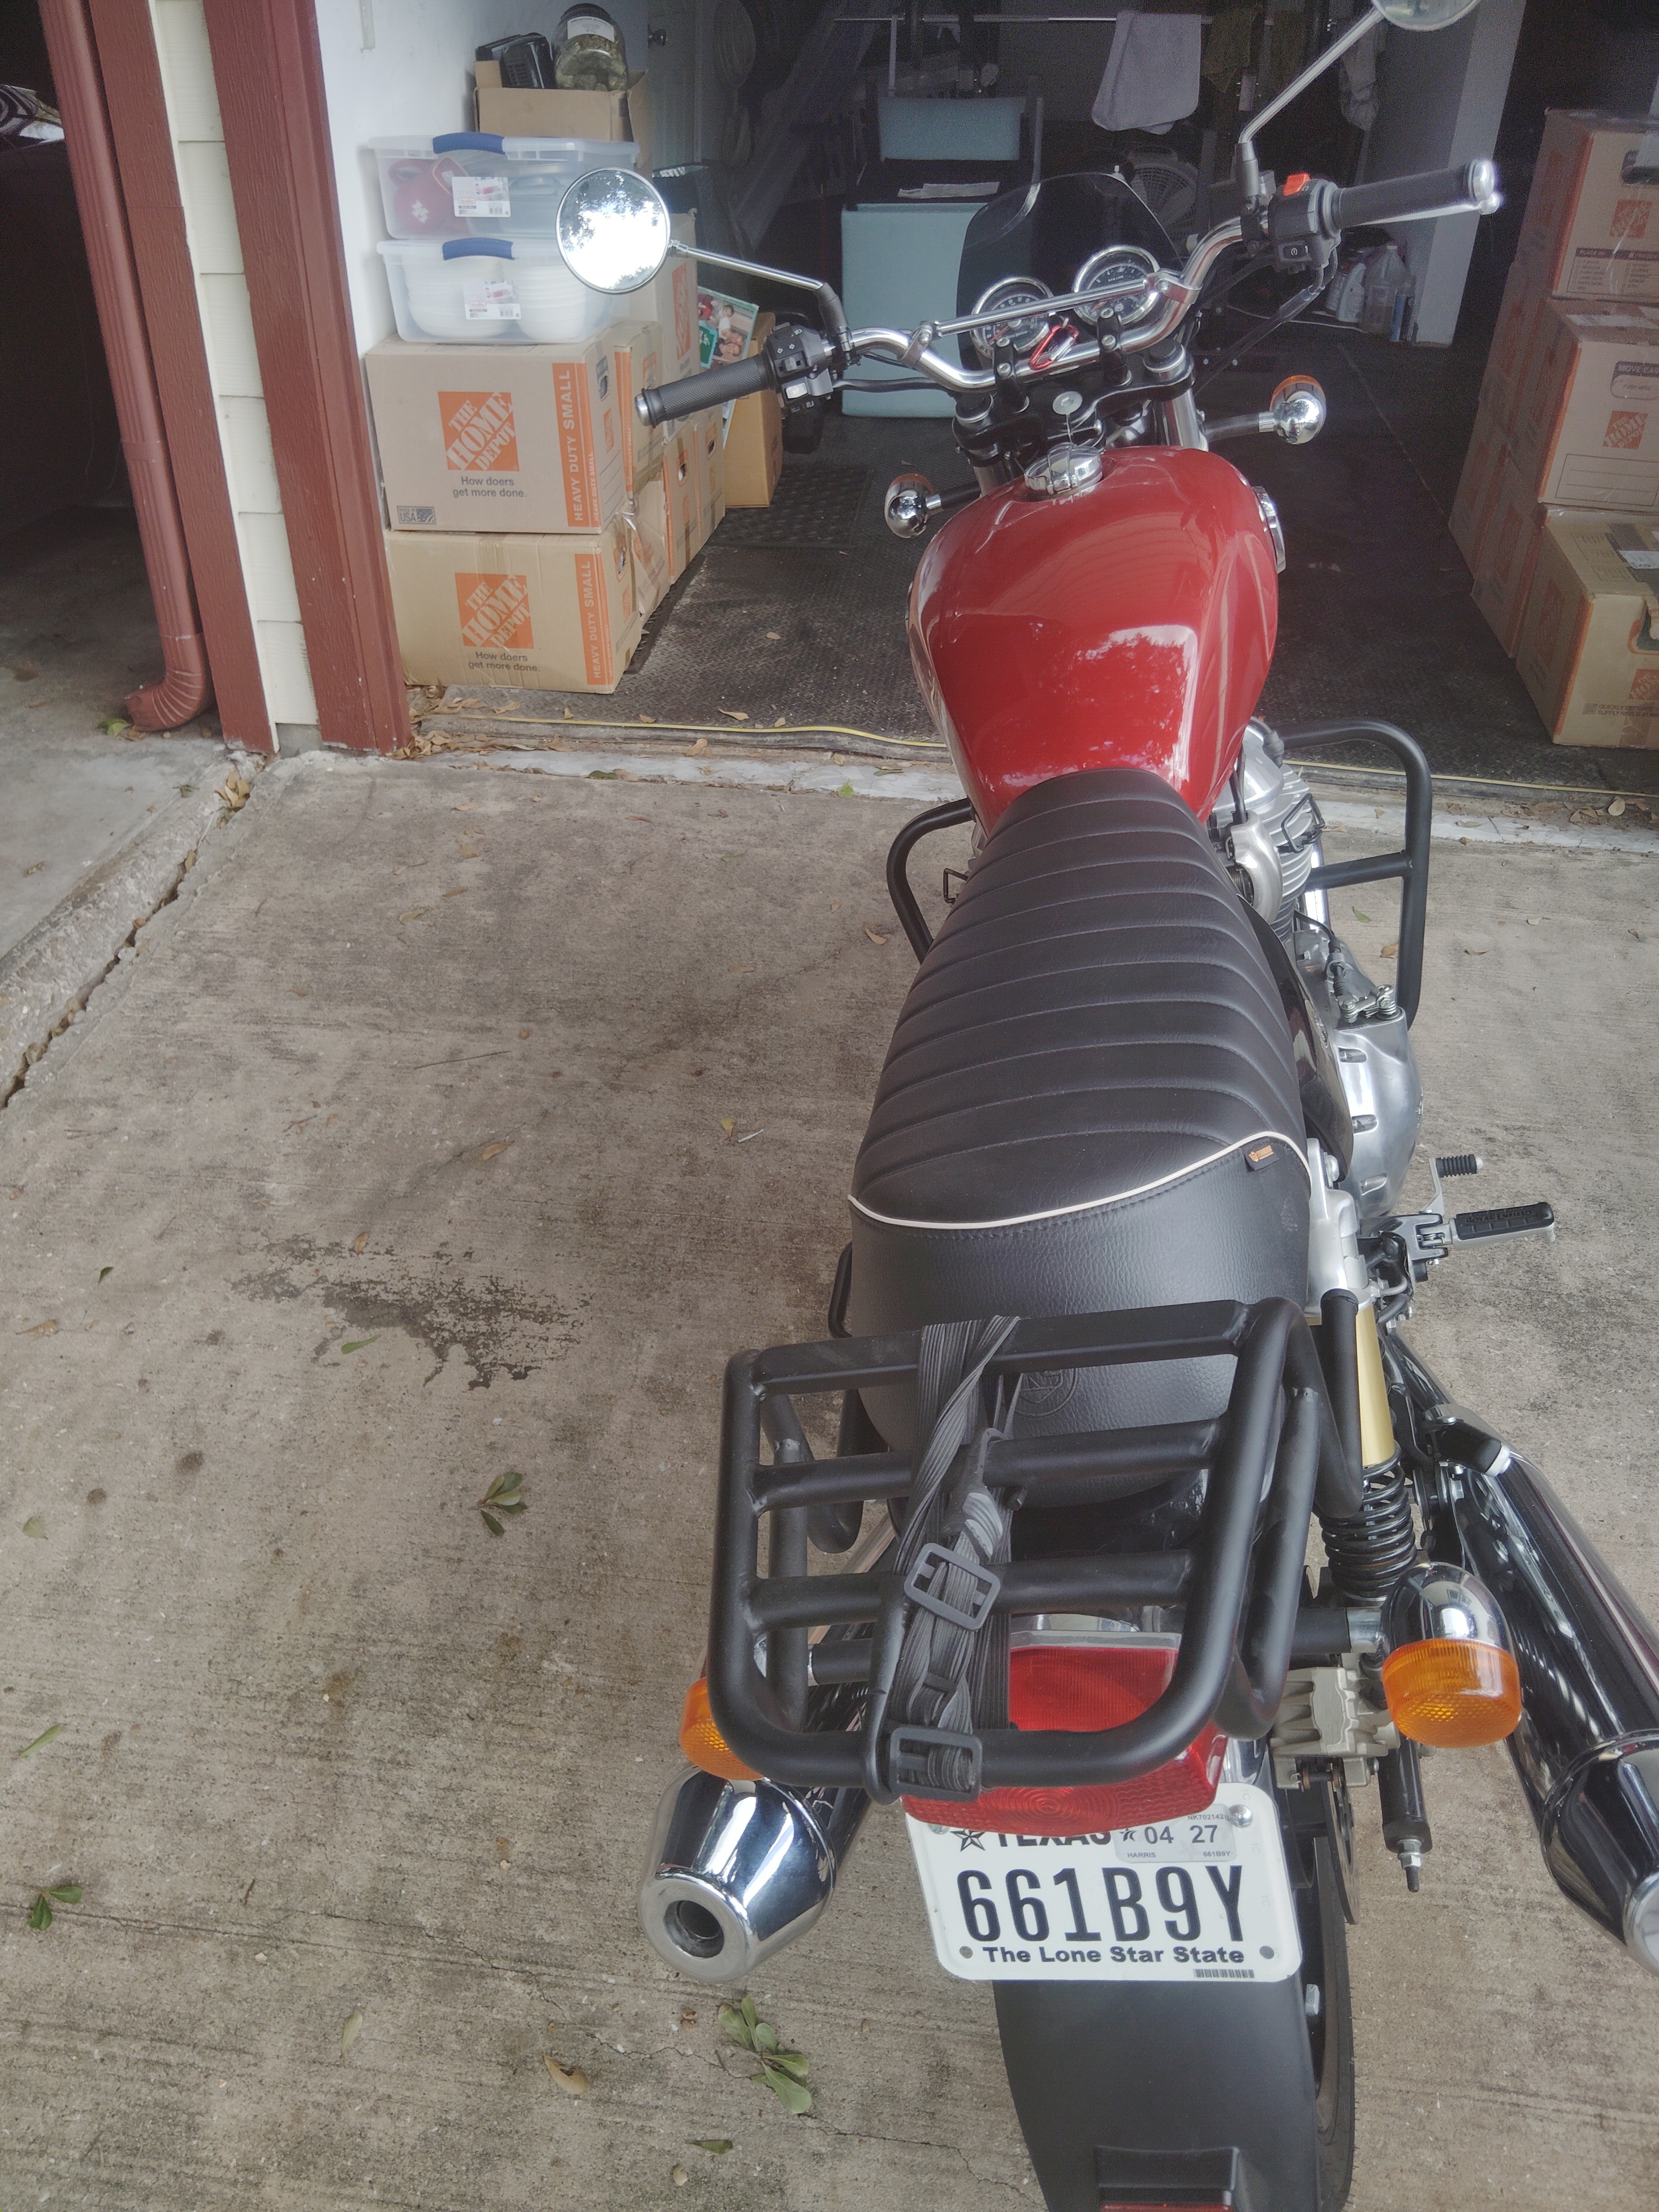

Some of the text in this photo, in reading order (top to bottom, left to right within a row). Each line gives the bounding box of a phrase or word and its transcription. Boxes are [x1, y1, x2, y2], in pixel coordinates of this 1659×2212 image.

[446, 392, 513, 470] HOME
[448, 400, 477, 431] THE
[475, 422, 516, 470] DEPOT
[559, 370, 583, 521] HEAVY DUTY SMALL
[453, 488, 469, 498] get
[500, 488, 527, 497] done.
[461, 476, 514, 485] How doers
[400, 512, 416, 522] USA
[462, 575, 528, 647] HOME
[464, 581, 493, 611] THE
[490, 603, 531, 648] DEPOT
[581, 562, 602, 678] HEAVY DUTY SMALL
[476, 651, 528, 662] How doers
[1144, 1825, 1218, 1844] 04 27
[957, 1865, 1244, 1942] 661B9Y
[982, 1946, 1244, 1963] The Lone Star State
